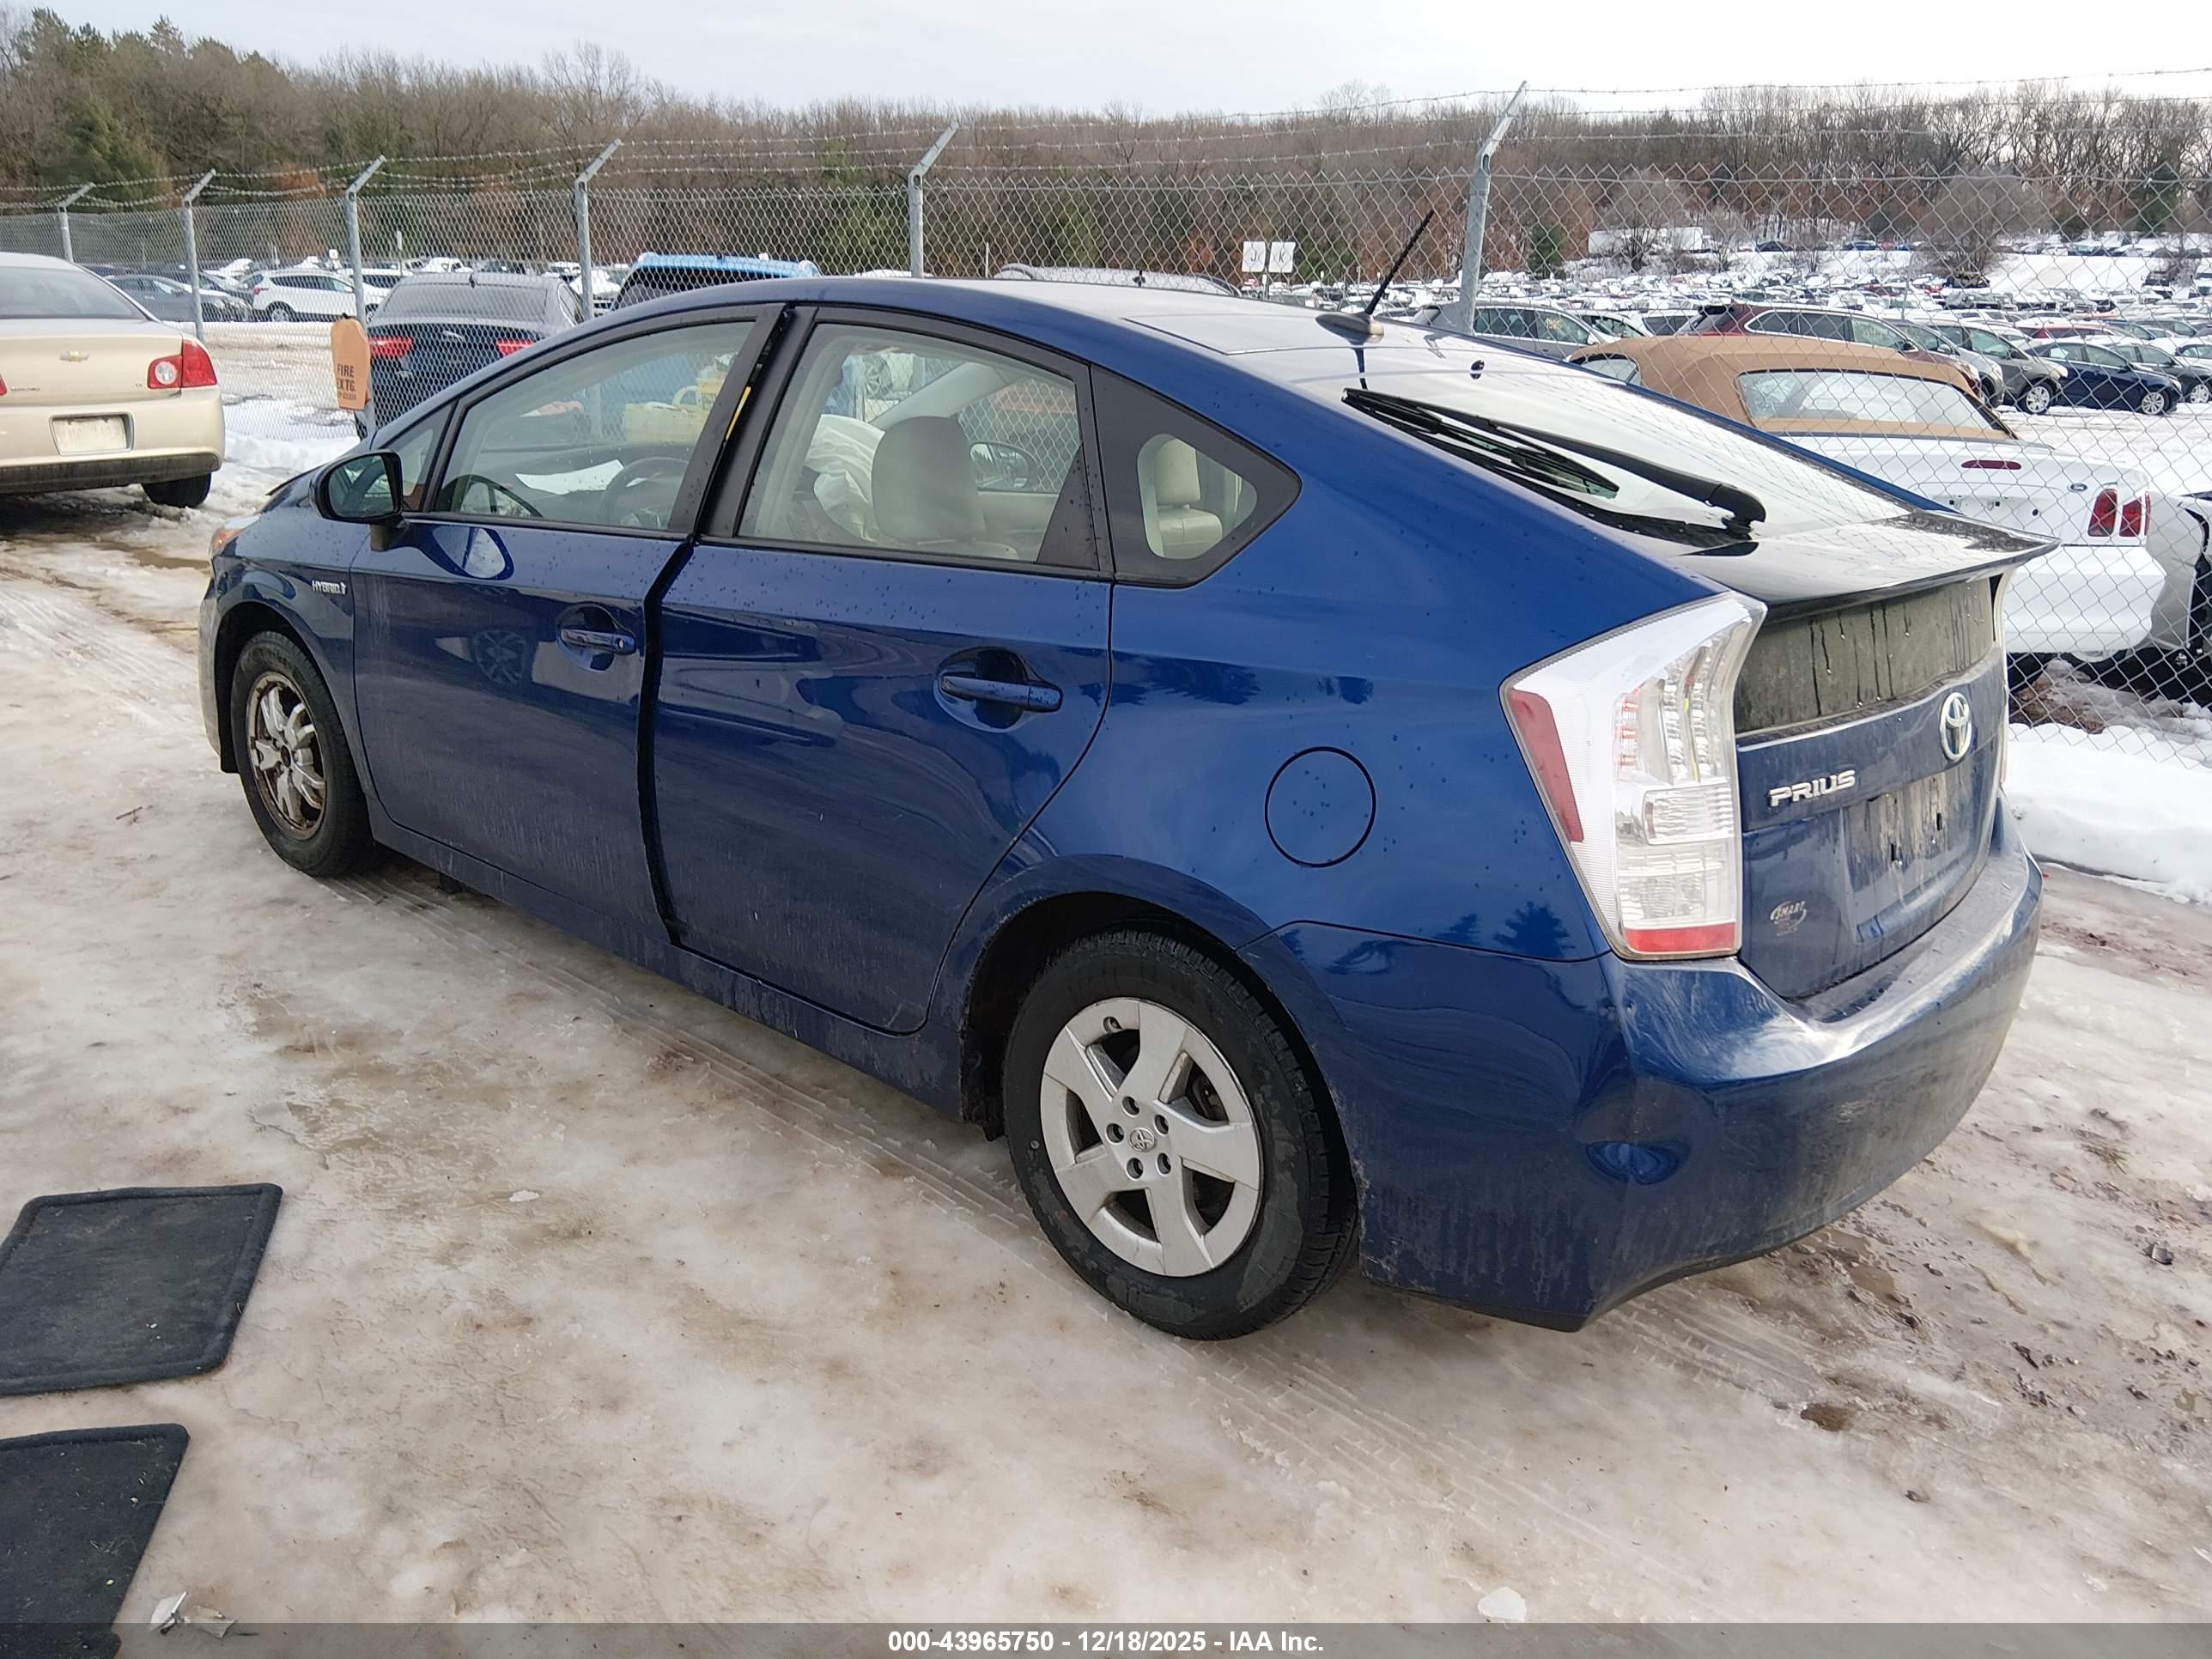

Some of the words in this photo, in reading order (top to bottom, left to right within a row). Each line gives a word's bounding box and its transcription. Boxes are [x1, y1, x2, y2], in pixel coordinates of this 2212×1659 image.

[1278, 251, 1285, 264] K
[337, 363, 355, 378] FIRE
[1769, 769, 1856, 807] PRIUS
